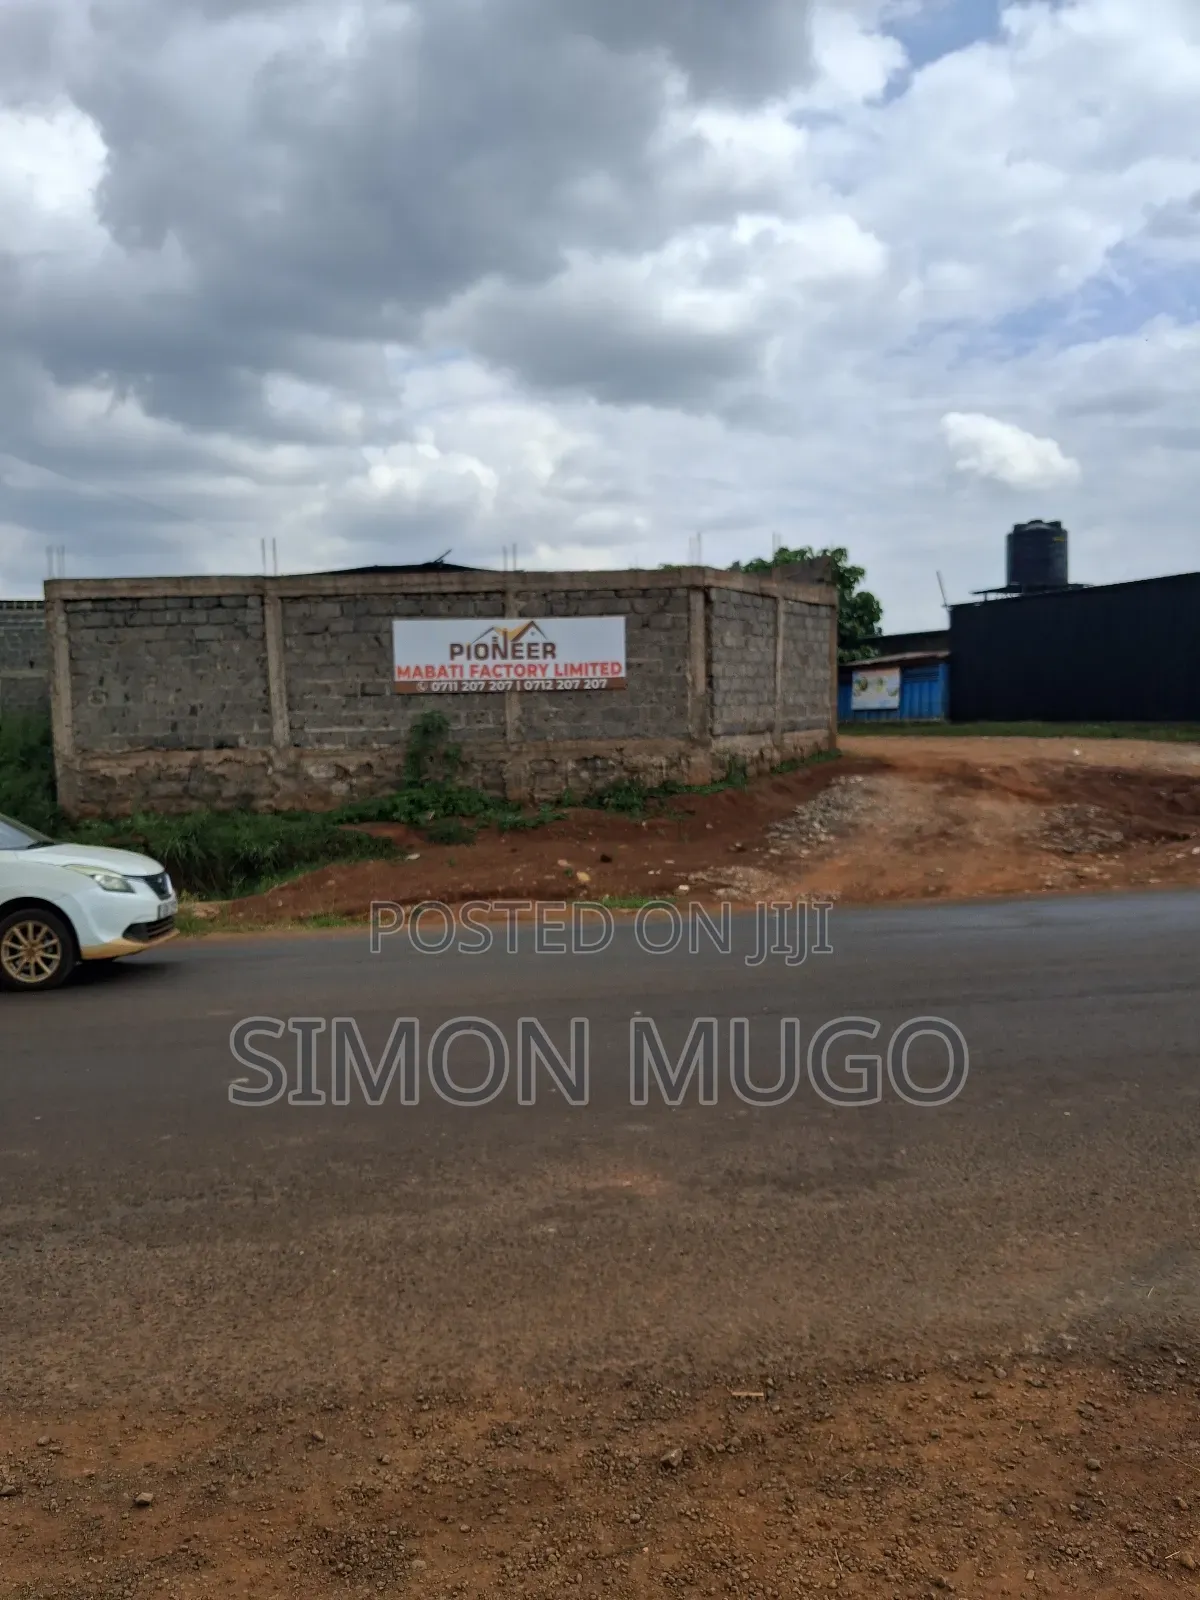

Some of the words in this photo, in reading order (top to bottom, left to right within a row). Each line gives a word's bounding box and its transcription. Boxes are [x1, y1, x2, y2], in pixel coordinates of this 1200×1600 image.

[449, 632, 557, 661] PIONEER
[397, 664, 464, 680] MABATI
[470, 663, 549, 679] FACTORY
[554, 661, 623, 677] LIMITED
[431, 681, 458, 692] 0711
[461, 681, 485, 692] 207
[489, 681, 513, 692] 207
[525, 680, 553, 691] 0712
[557, 679, 580, 691] 207
[583, 678, 608, 690] 207
